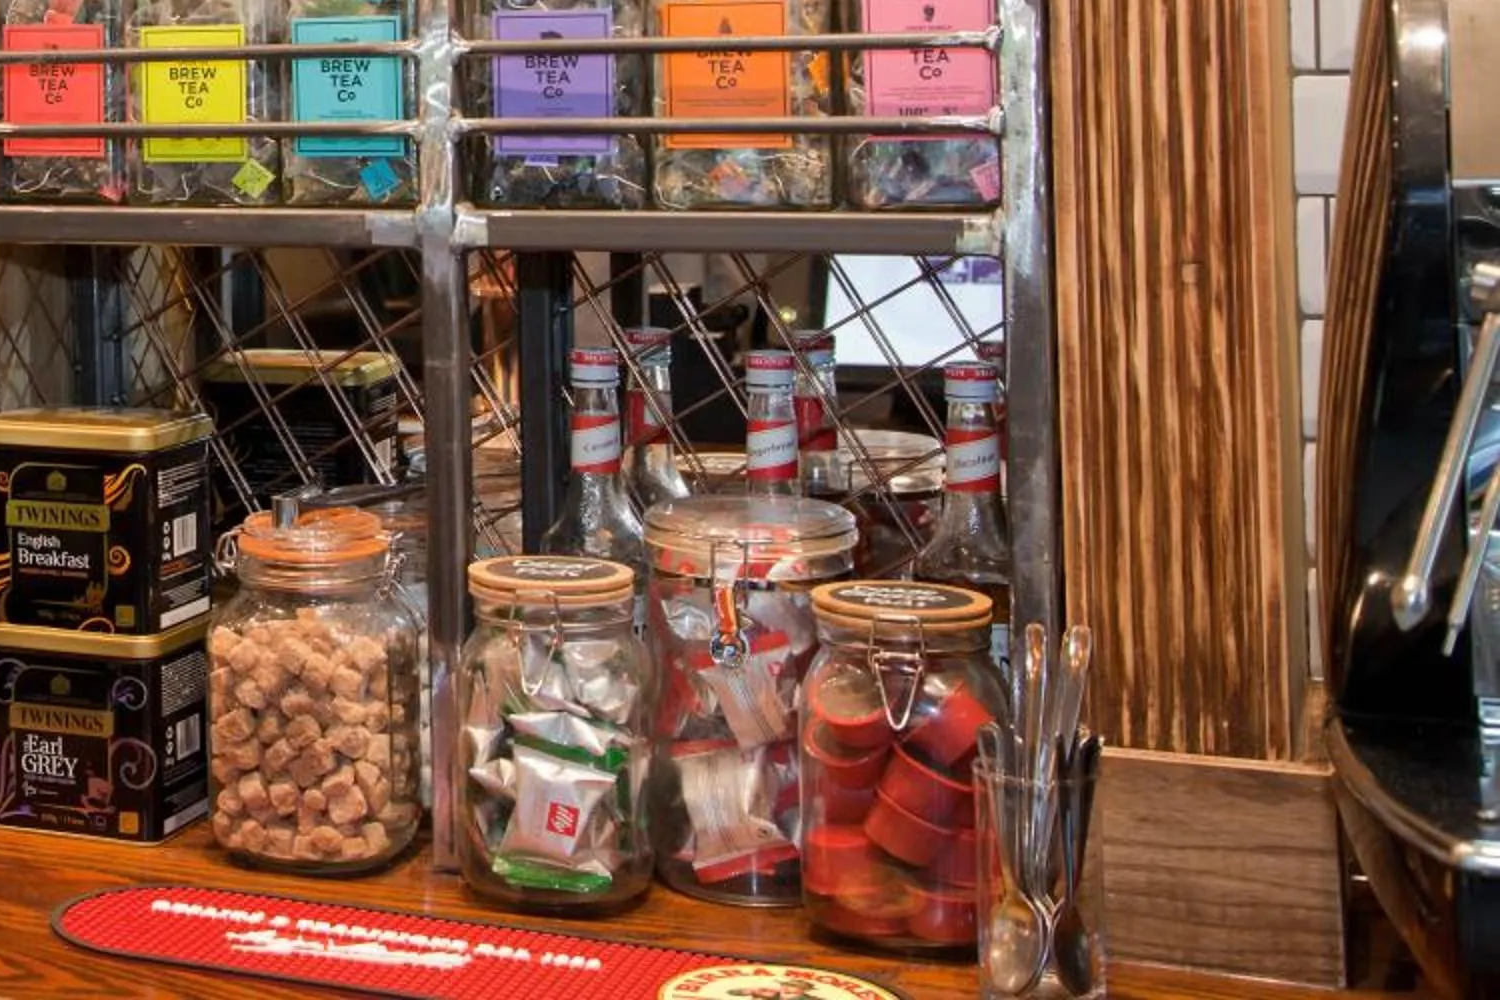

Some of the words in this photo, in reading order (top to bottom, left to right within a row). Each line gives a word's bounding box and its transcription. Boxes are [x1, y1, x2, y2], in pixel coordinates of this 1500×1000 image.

[525, 55, 579, 69] BREW
[910, 48, 949, 64] TEA
[29, 63, 76, 77] BREW
[321, 59, 370, 73] BREW
[708, 60, 745, 74] TEA
[919, 65, 942, 80] Co
[169, 66, 218, 81] BREW
[330, 74, 362, 87] TEA
[535, 70, 570, 84] TEA
[39, 78, 68, 91] TEA
[178, 80, 209, 94] TEA
[716, 75, 737, 89] Co
[45, 92, 63, 105] Co
[337, 89, 356, 102] Co
[543, 85, 564, 99] Co
[185, 95, 203, 109] Co
[16, 505, 101, 525] TWININGS
[17, 532, 61, 551] English
[18, 547, 90, 569] Breakfast
[20, 708, 104, 733] TWININGS
[27, 733, 63, 757] Earl
[21, 753, 79, 779] GREY
